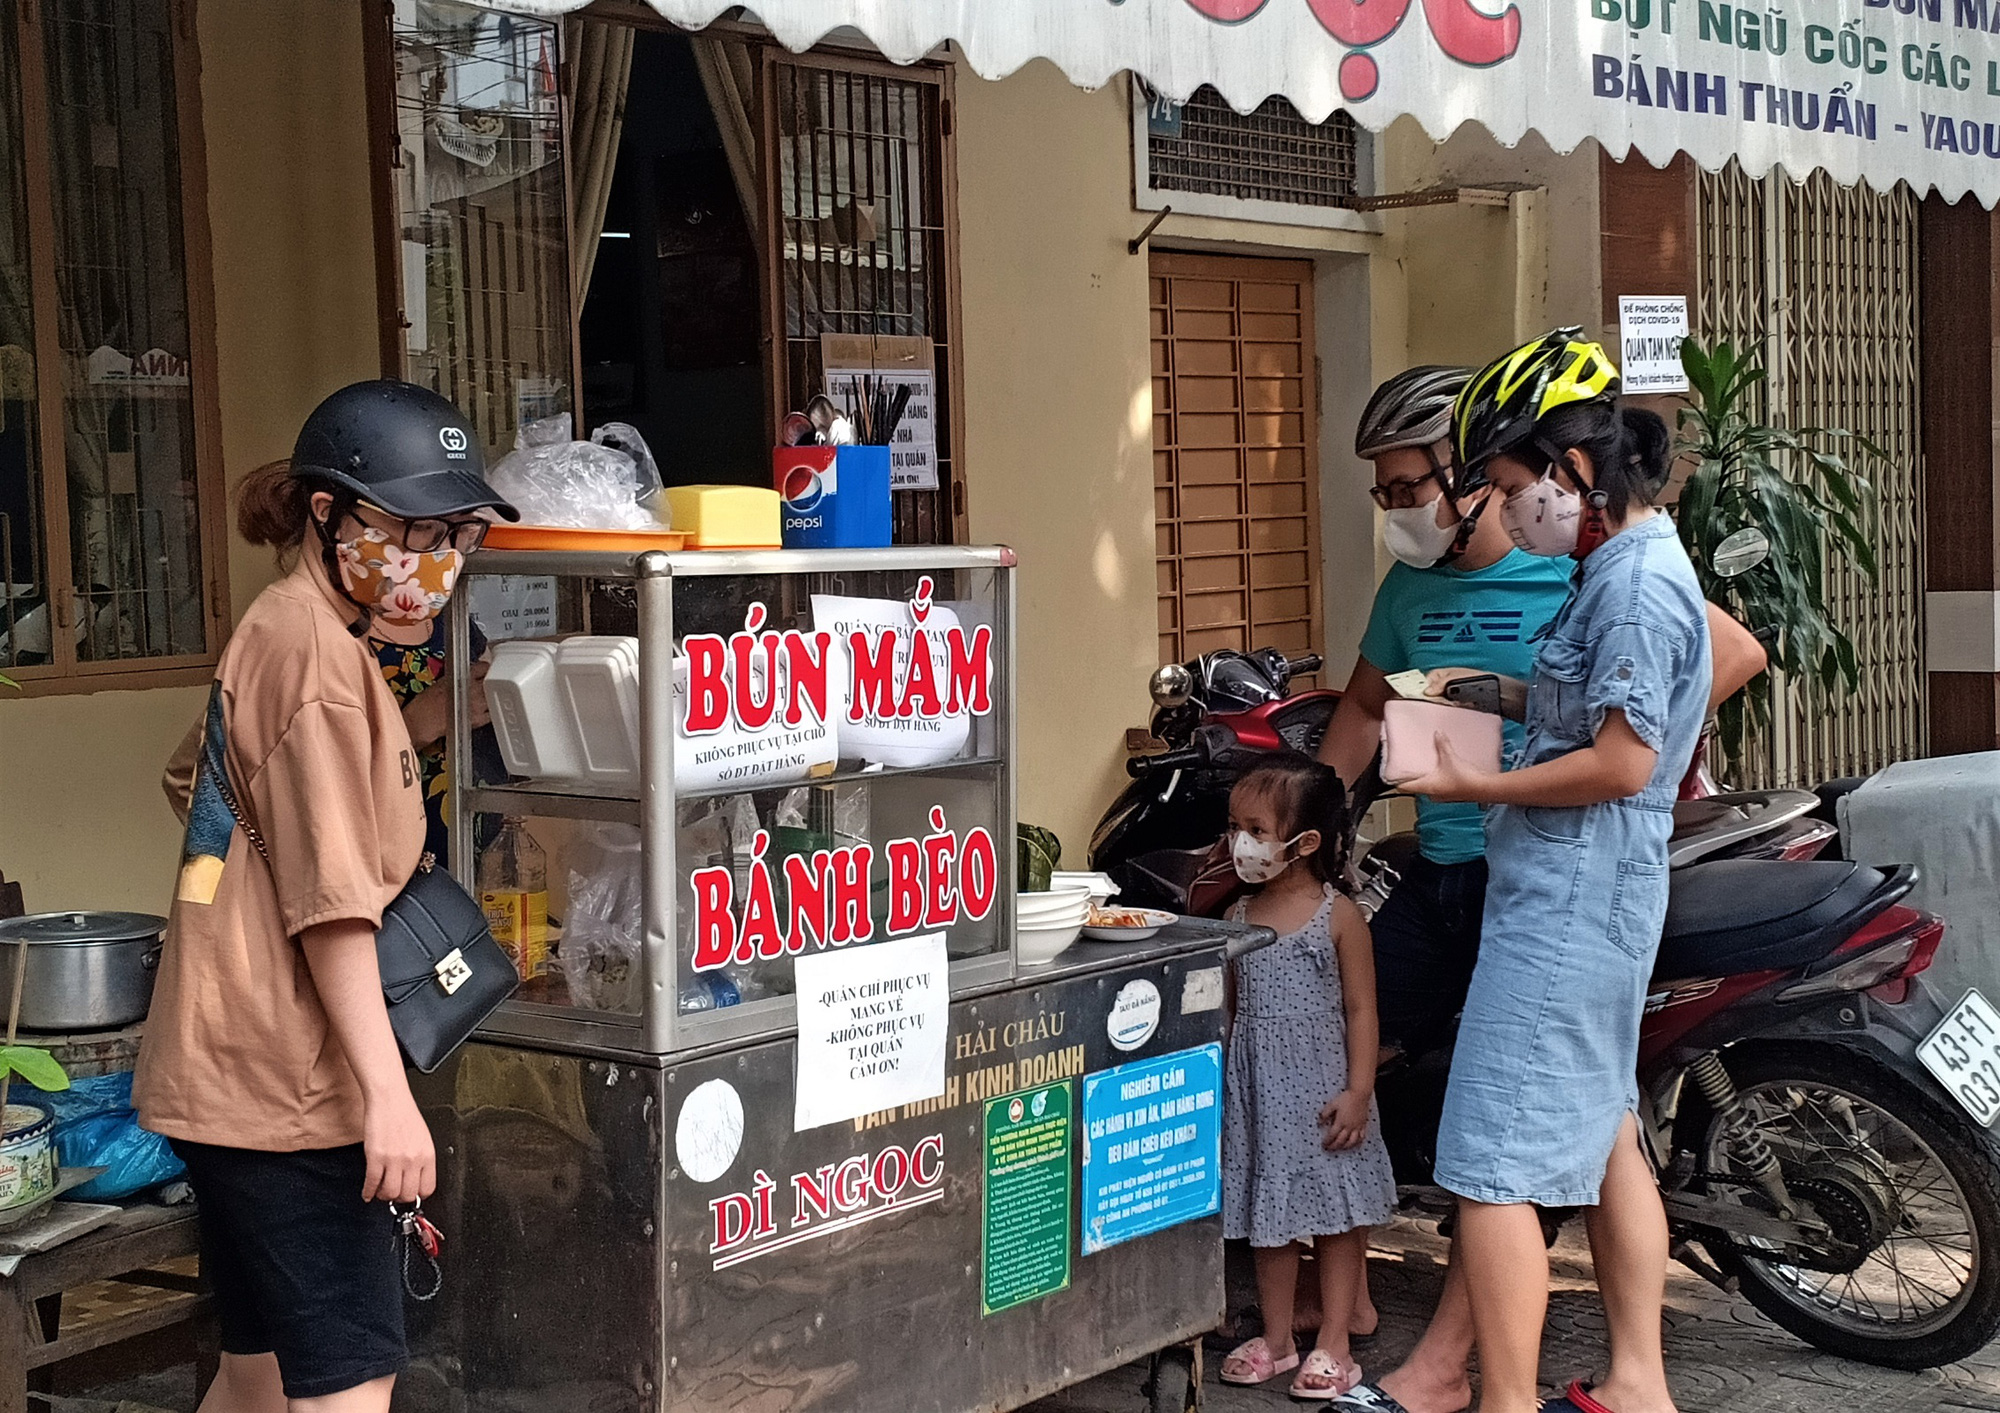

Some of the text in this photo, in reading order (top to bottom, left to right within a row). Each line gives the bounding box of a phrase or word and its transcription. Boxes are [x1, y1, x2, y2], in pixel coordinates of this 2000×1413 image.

[1701, 3, 1787, 57] NGŨ
[1805, 18, 1888, 75] CỐC
[1902, 42, 1970, 92] CÁC
[1593, 53, 1727, 116] BÁNH
[1739, 81, 1877, 141] THUẨN
[1635, 303, 1659, 313] PHÒNG
[1660, 303, 1684, 313] CHỐNG
[1648, 316, 1680, 324] COVID-19
[907, 402, 928, 419] HÀNG
[897, 426, 913, 443] NHÀ
[892, 449, 926, 470] TẠI QUÁN
[786, 515, 822, 530] pepsi
[682, 602, 831, 735] BÚN
[847, 575, 991, 722] MẮM
[695, 745, 735, 765] KHÔNG
[738, 739, 766, 756] PHỤC
[767, 737, 782, 750] VỤ
[784, 731, 801, 747] TẠI
[717, 767, 732, 782] SỐ
[775, 753, 805, 770] HÀNG
[691, 805, 997, 972] BÁNH BÈO
[819, 972, 931, 1008] -QUÁN CHỈ PHỤC VỤ
[851, 995, 903, 1021] MANG VỀ
[826, 1013, 925, 1045] -KHÔNG PHỤC VỤ
[955, 1010, 1066, 1060] HẢI CHÂU
[848, 1035, 903, 1062] TẠI QUÁN
[850, 1058, 899, 1080] CẢM ƠN!
[966, 1062, 1015, 1103] KINH
[1020, 1044, 1085, 1088] DOANH
[1120, 1065, 1185, 1101] NGHIÊM CẤM
[1960, 1044, 2000, 1116] 032
[1090, 1116, 1105, 1140] CÁC
[1105, 1112, 1125, 1135] HÀNH
[1134, 1107, 1147, 1127] XIN
[1161, 1097, 1176, 1120] BÁN
[1176, 1093, 1195, 1115] HÀNG
[1123, 1137, 1140, 1160] BÁM
[1141, 1132, 1159, 1155] CHÈO
[1160, 1127, 1173, 1149] KÉO
[1174, 1122, 1196, 1145] KHÁCH
[709, 1132, 945, 1254] DÌ NGỌC
